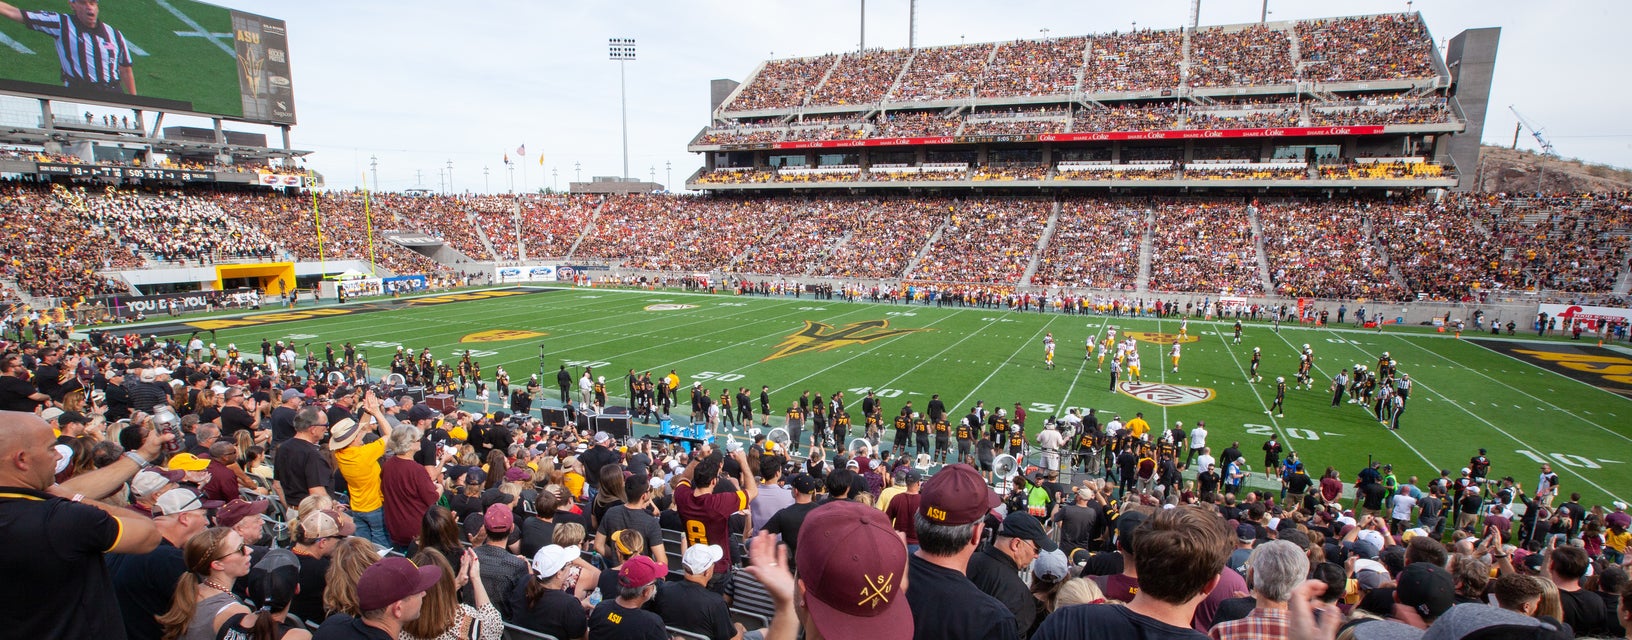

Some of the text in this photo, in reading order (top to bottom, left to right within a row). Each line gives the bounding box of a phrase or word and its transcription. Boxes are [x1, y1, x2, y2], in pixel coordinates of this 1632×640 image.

[237, 29, 260, 44] ASU
[1330, 127, 1350, 135] Coke
[125, 299, 156, 313] YOU
[183, 295, 207, 308] YOU
[691, 371, 746, 382] 50
[847, 386, 904, 398] 40
[1243, 423, 1321, 441] 20
[1515, 450, 1602, 469] 10
[927, 506, 947, 521] ASU
[1128, 586, 1139, 595] AS
[607, 612, 622, 624] ASU
